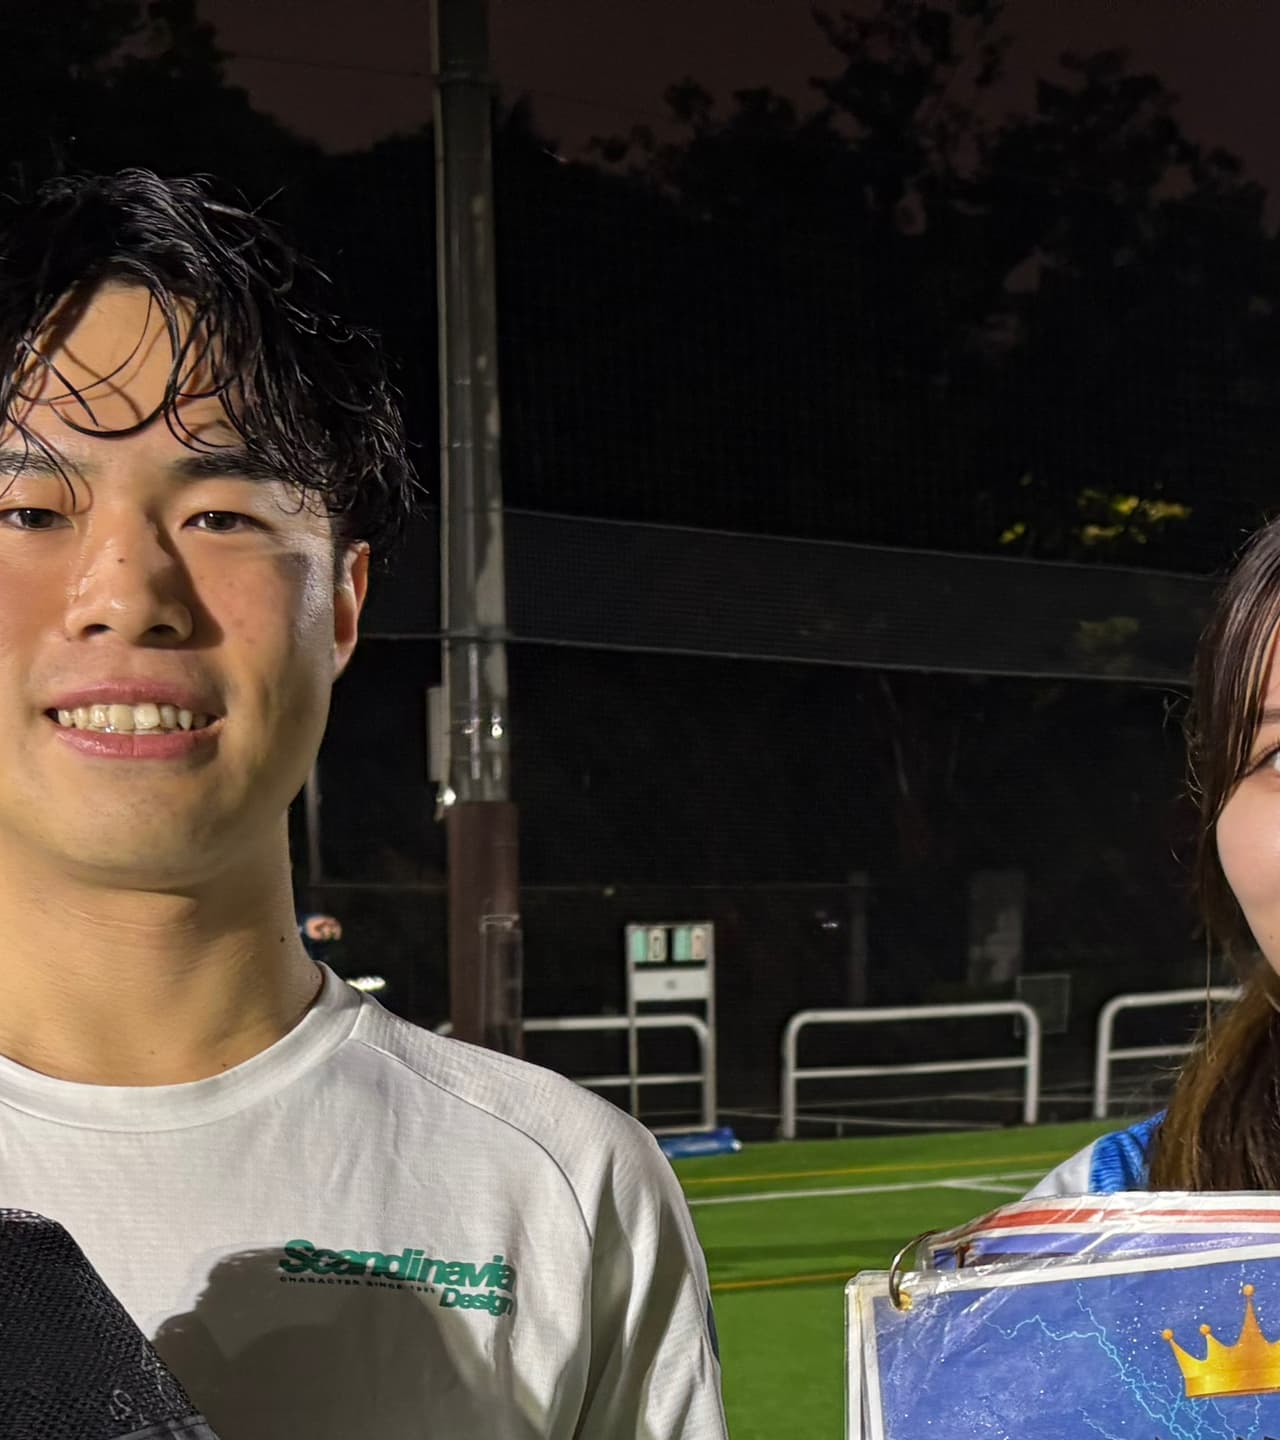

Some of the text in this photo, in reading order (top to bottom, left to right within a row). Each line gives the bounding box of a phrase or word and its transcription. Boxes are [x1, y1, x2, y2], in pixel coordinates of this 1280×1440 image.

[279, 1239, 515, 1292] Scandinavia
[279, 1275, 360, 1287] CHARACTER
[439, 1287, 513, 1316] Design
